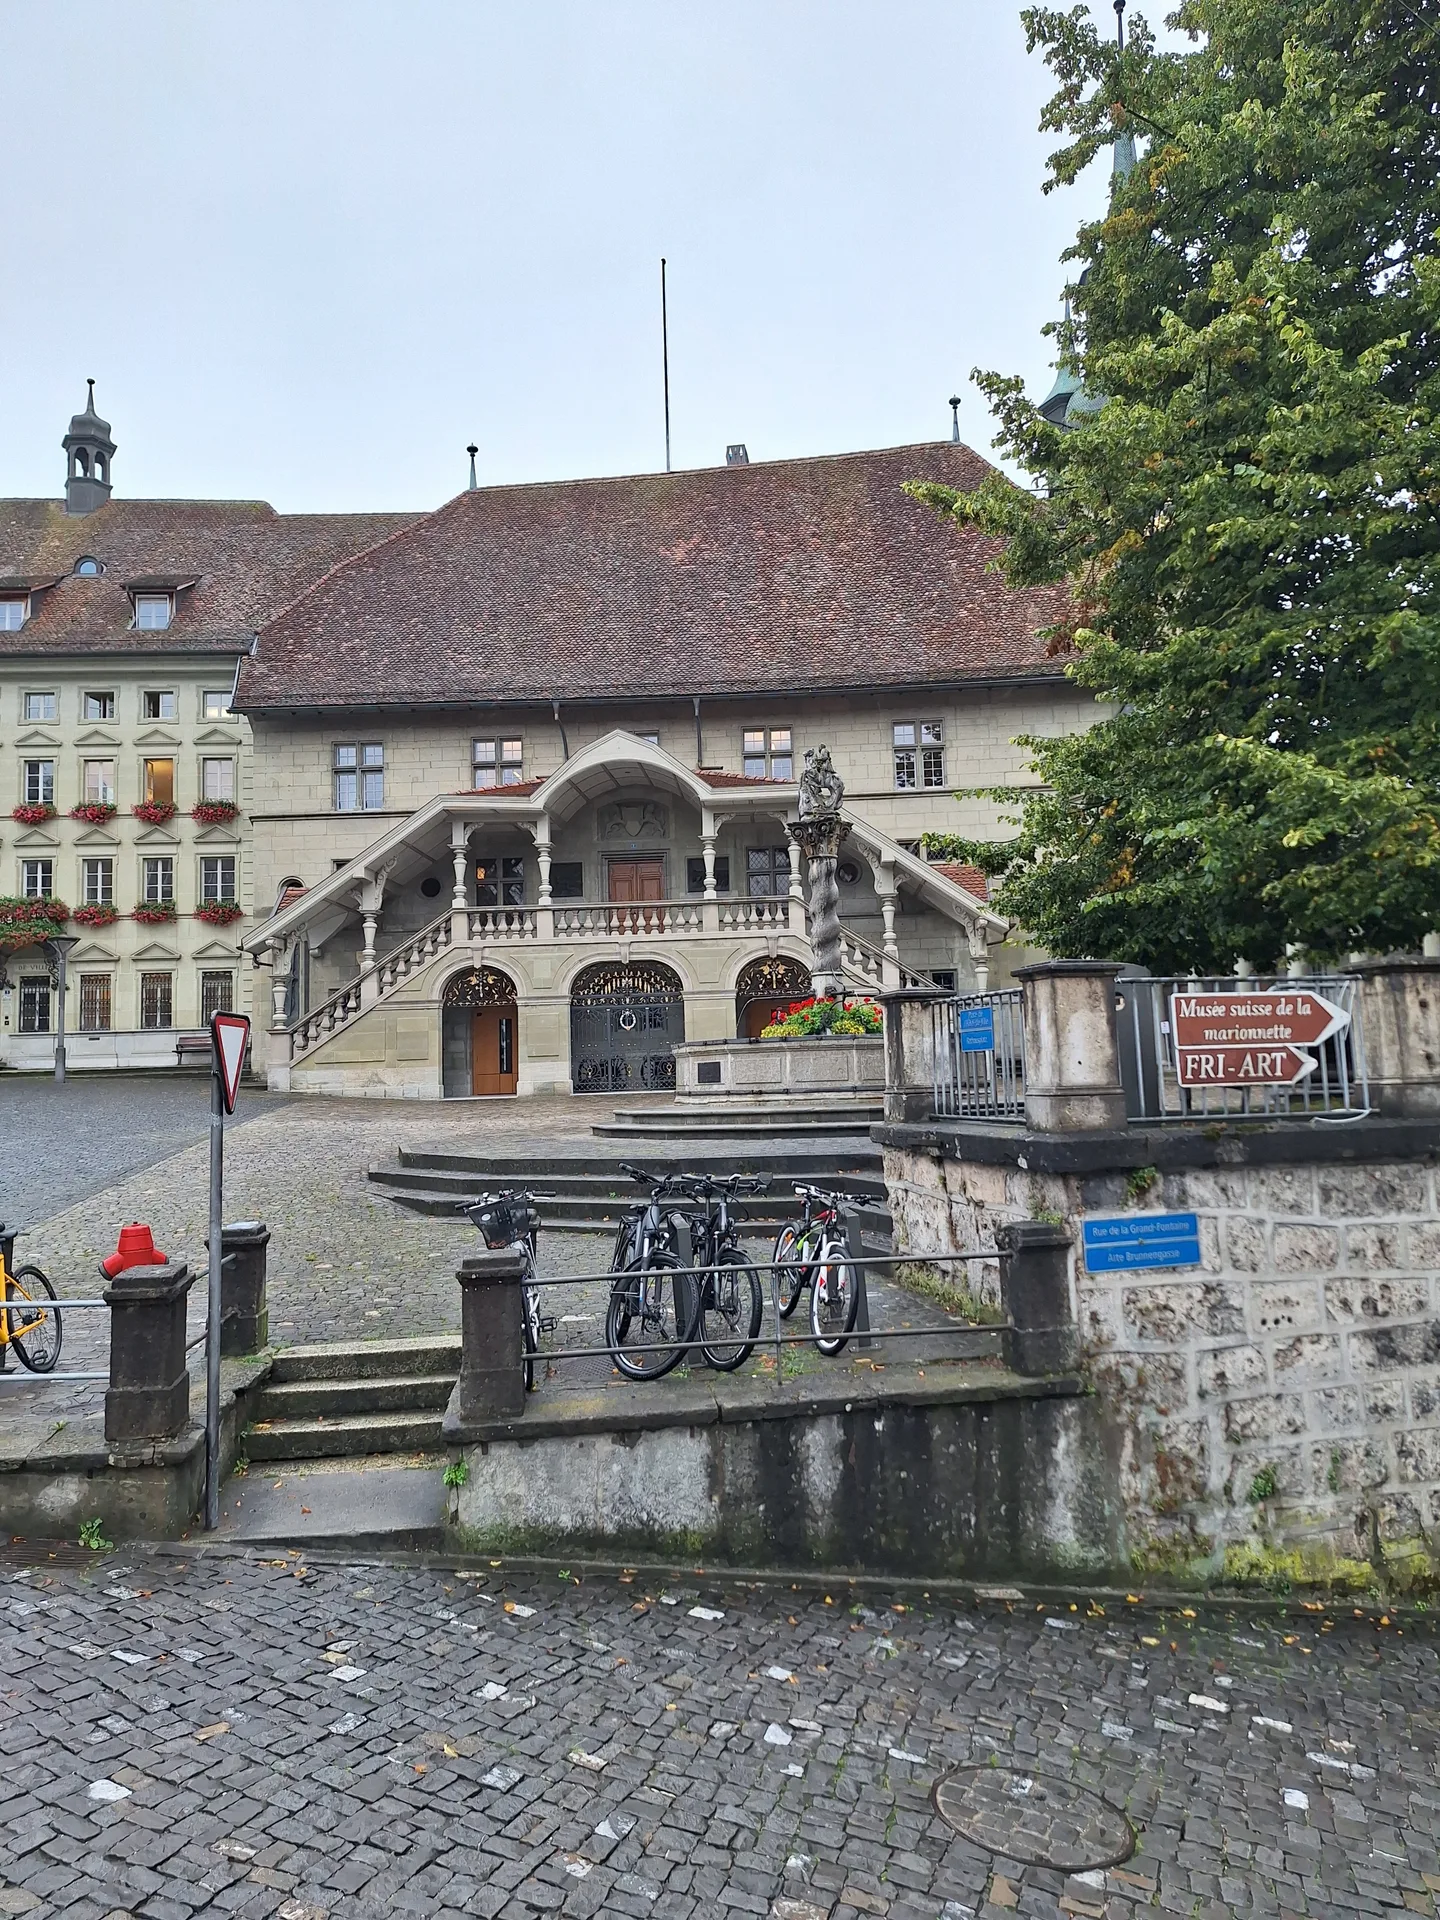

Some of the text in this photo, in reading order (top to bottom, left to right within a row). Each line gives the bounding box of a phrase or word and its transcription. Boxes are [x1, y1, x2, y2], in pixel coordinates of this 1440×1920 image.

[1179, 997, 1312, 1018] Musée suisse de la
[1203, 1023, 1293, 1041] marionnette
[1092, 1226, 1108, 1237] Rue
[1108, 1225, 1120, 1236] de
[1120, 1224, 1129, 1235] la
[1126, 1249, 1180, 1262] Brunnengasse
